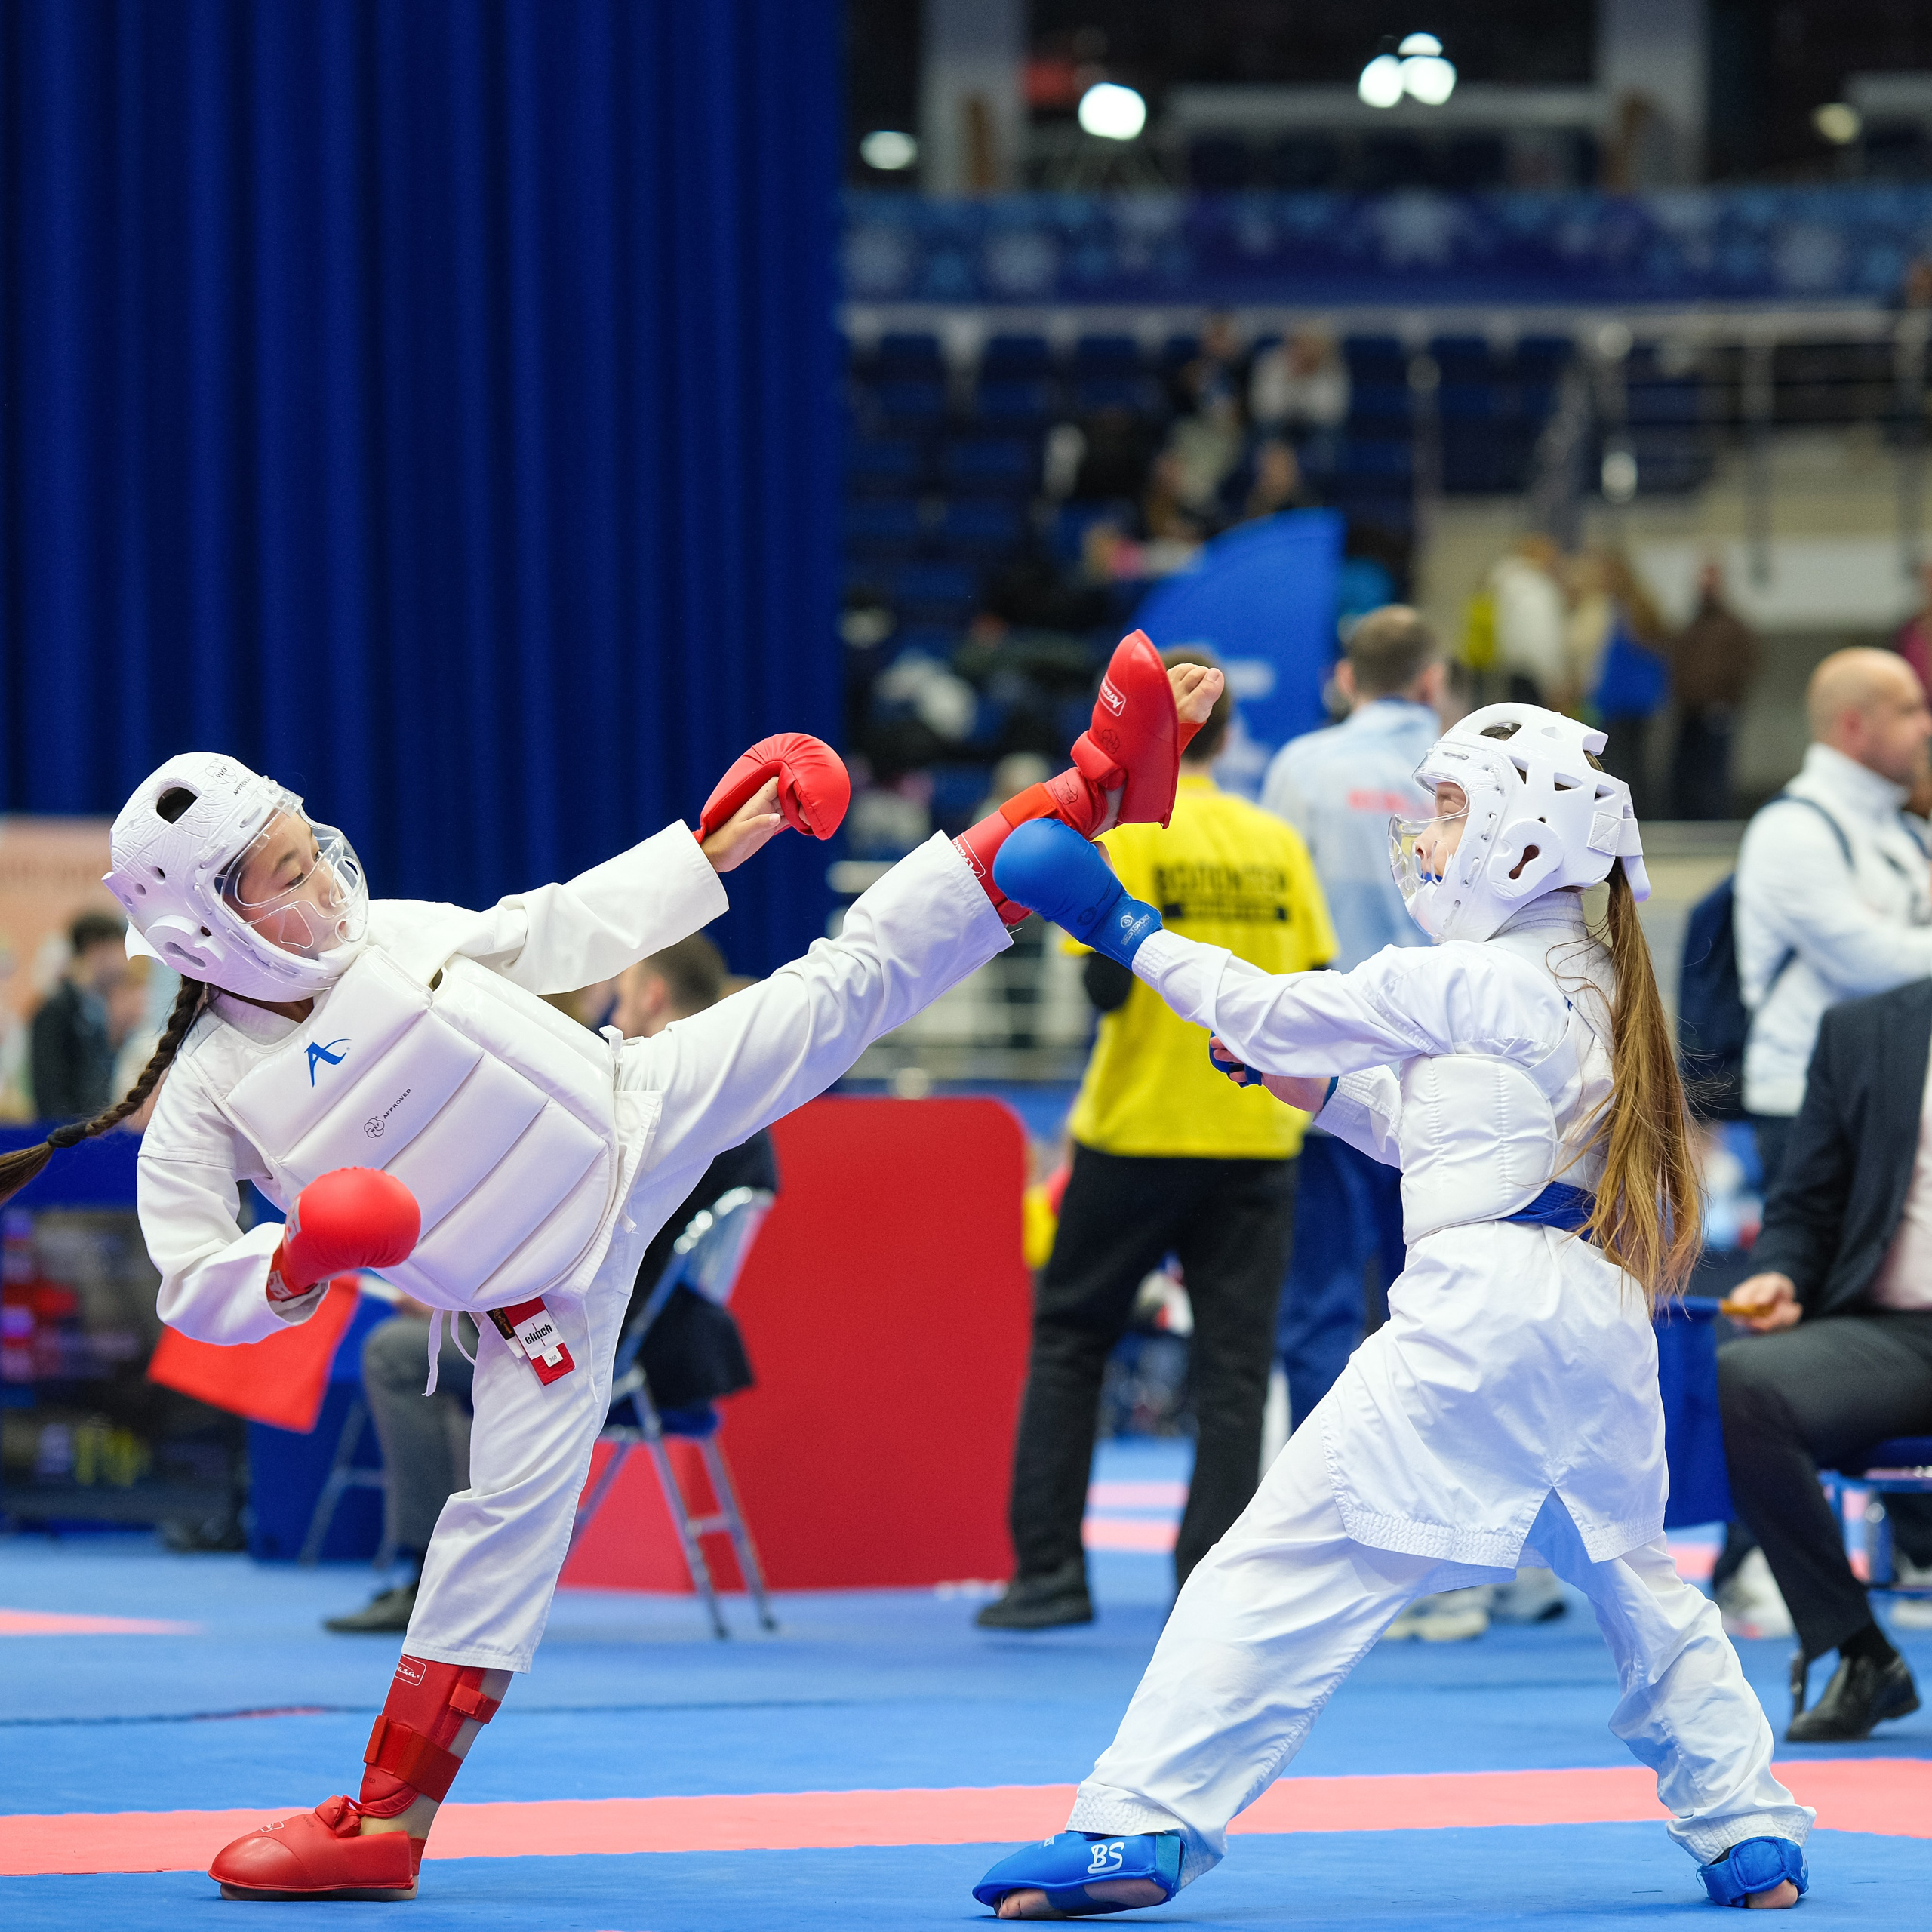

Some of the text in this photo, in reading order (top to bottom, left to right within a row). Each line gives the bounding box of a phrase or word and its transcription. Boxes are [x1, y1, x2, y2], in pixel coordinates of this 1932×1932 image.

[233, 777, 251, 795] APPROVED
[383, 1088, 411, 1119] APPROVED
[525, 1324, 553, 1345] clinch
[1088, 1842, 1124, 1874] BS
